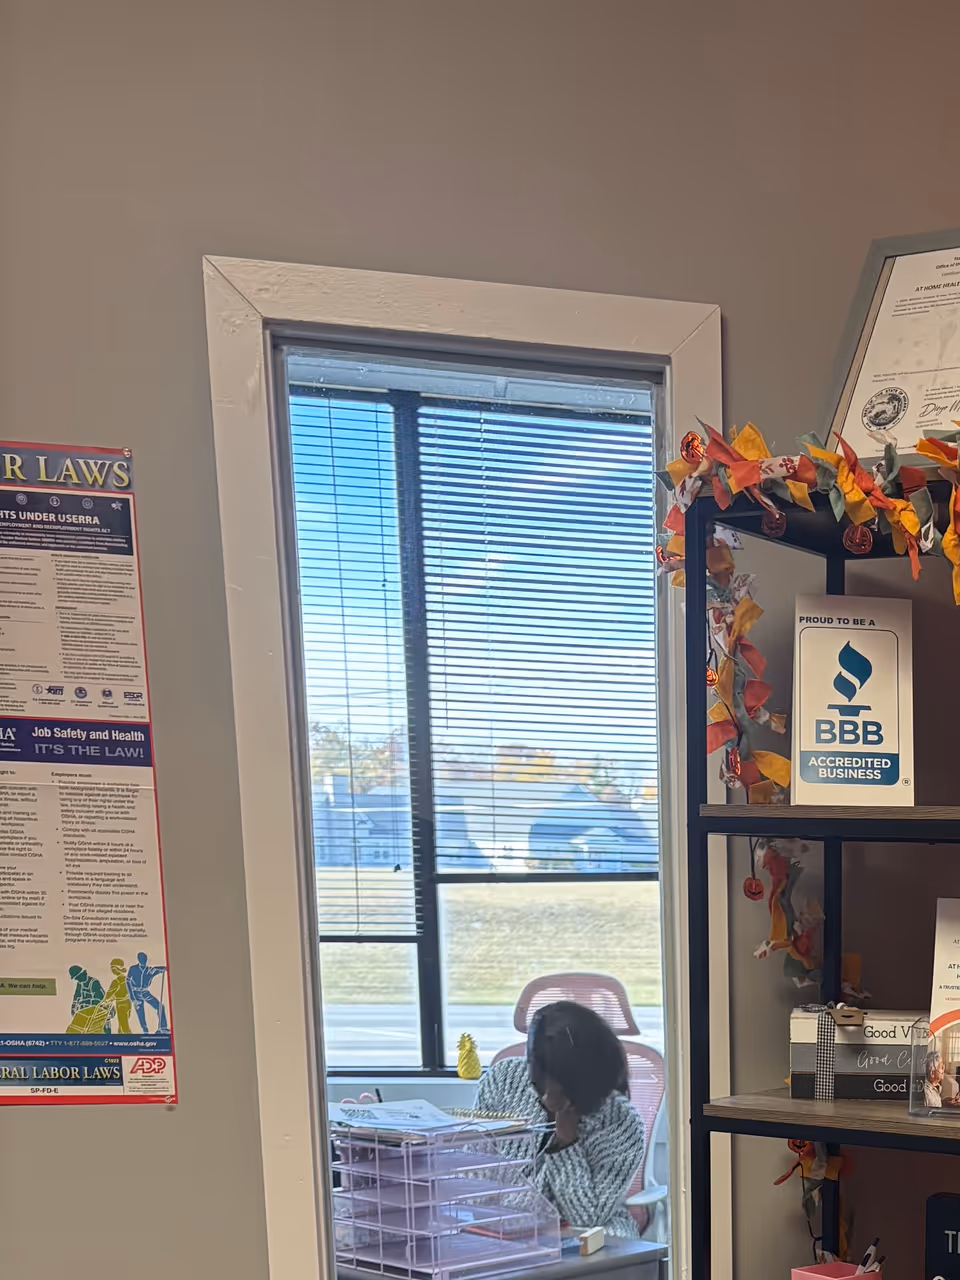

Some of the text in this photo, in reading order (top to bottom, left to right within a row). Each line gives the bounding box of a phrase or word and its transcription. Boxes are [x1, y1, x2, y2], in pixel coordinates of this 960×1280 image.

[924, 283, 942, 292] HOME
[36, 455, 129, 487] LAWS
[19, 511, 56, 522] UNDER
[58, 513, 100, 525] USERRA
[799, 616, 834, 624] PROUD
[836, 617, 849, 625] TO
[32, 726, 145, 742] Job Safety and Health
[815, 718, 884, 746] BBB
[34, 743, 145, 758] IT'S THE LAW!
[808, 756, 891, 769] ACCREDITED
[818, 767, 881, 780] BUSINESS
[863, 1025, 897, 1039] Good
[130, 1057, 166, 1074] ADP
[857, 1050, 892, 1069] Good
[33, 1066, 82, 1079] LABOR
[84, 1066, 121, 1079] LAWS
[873, 1078, 907, 1093] Good
